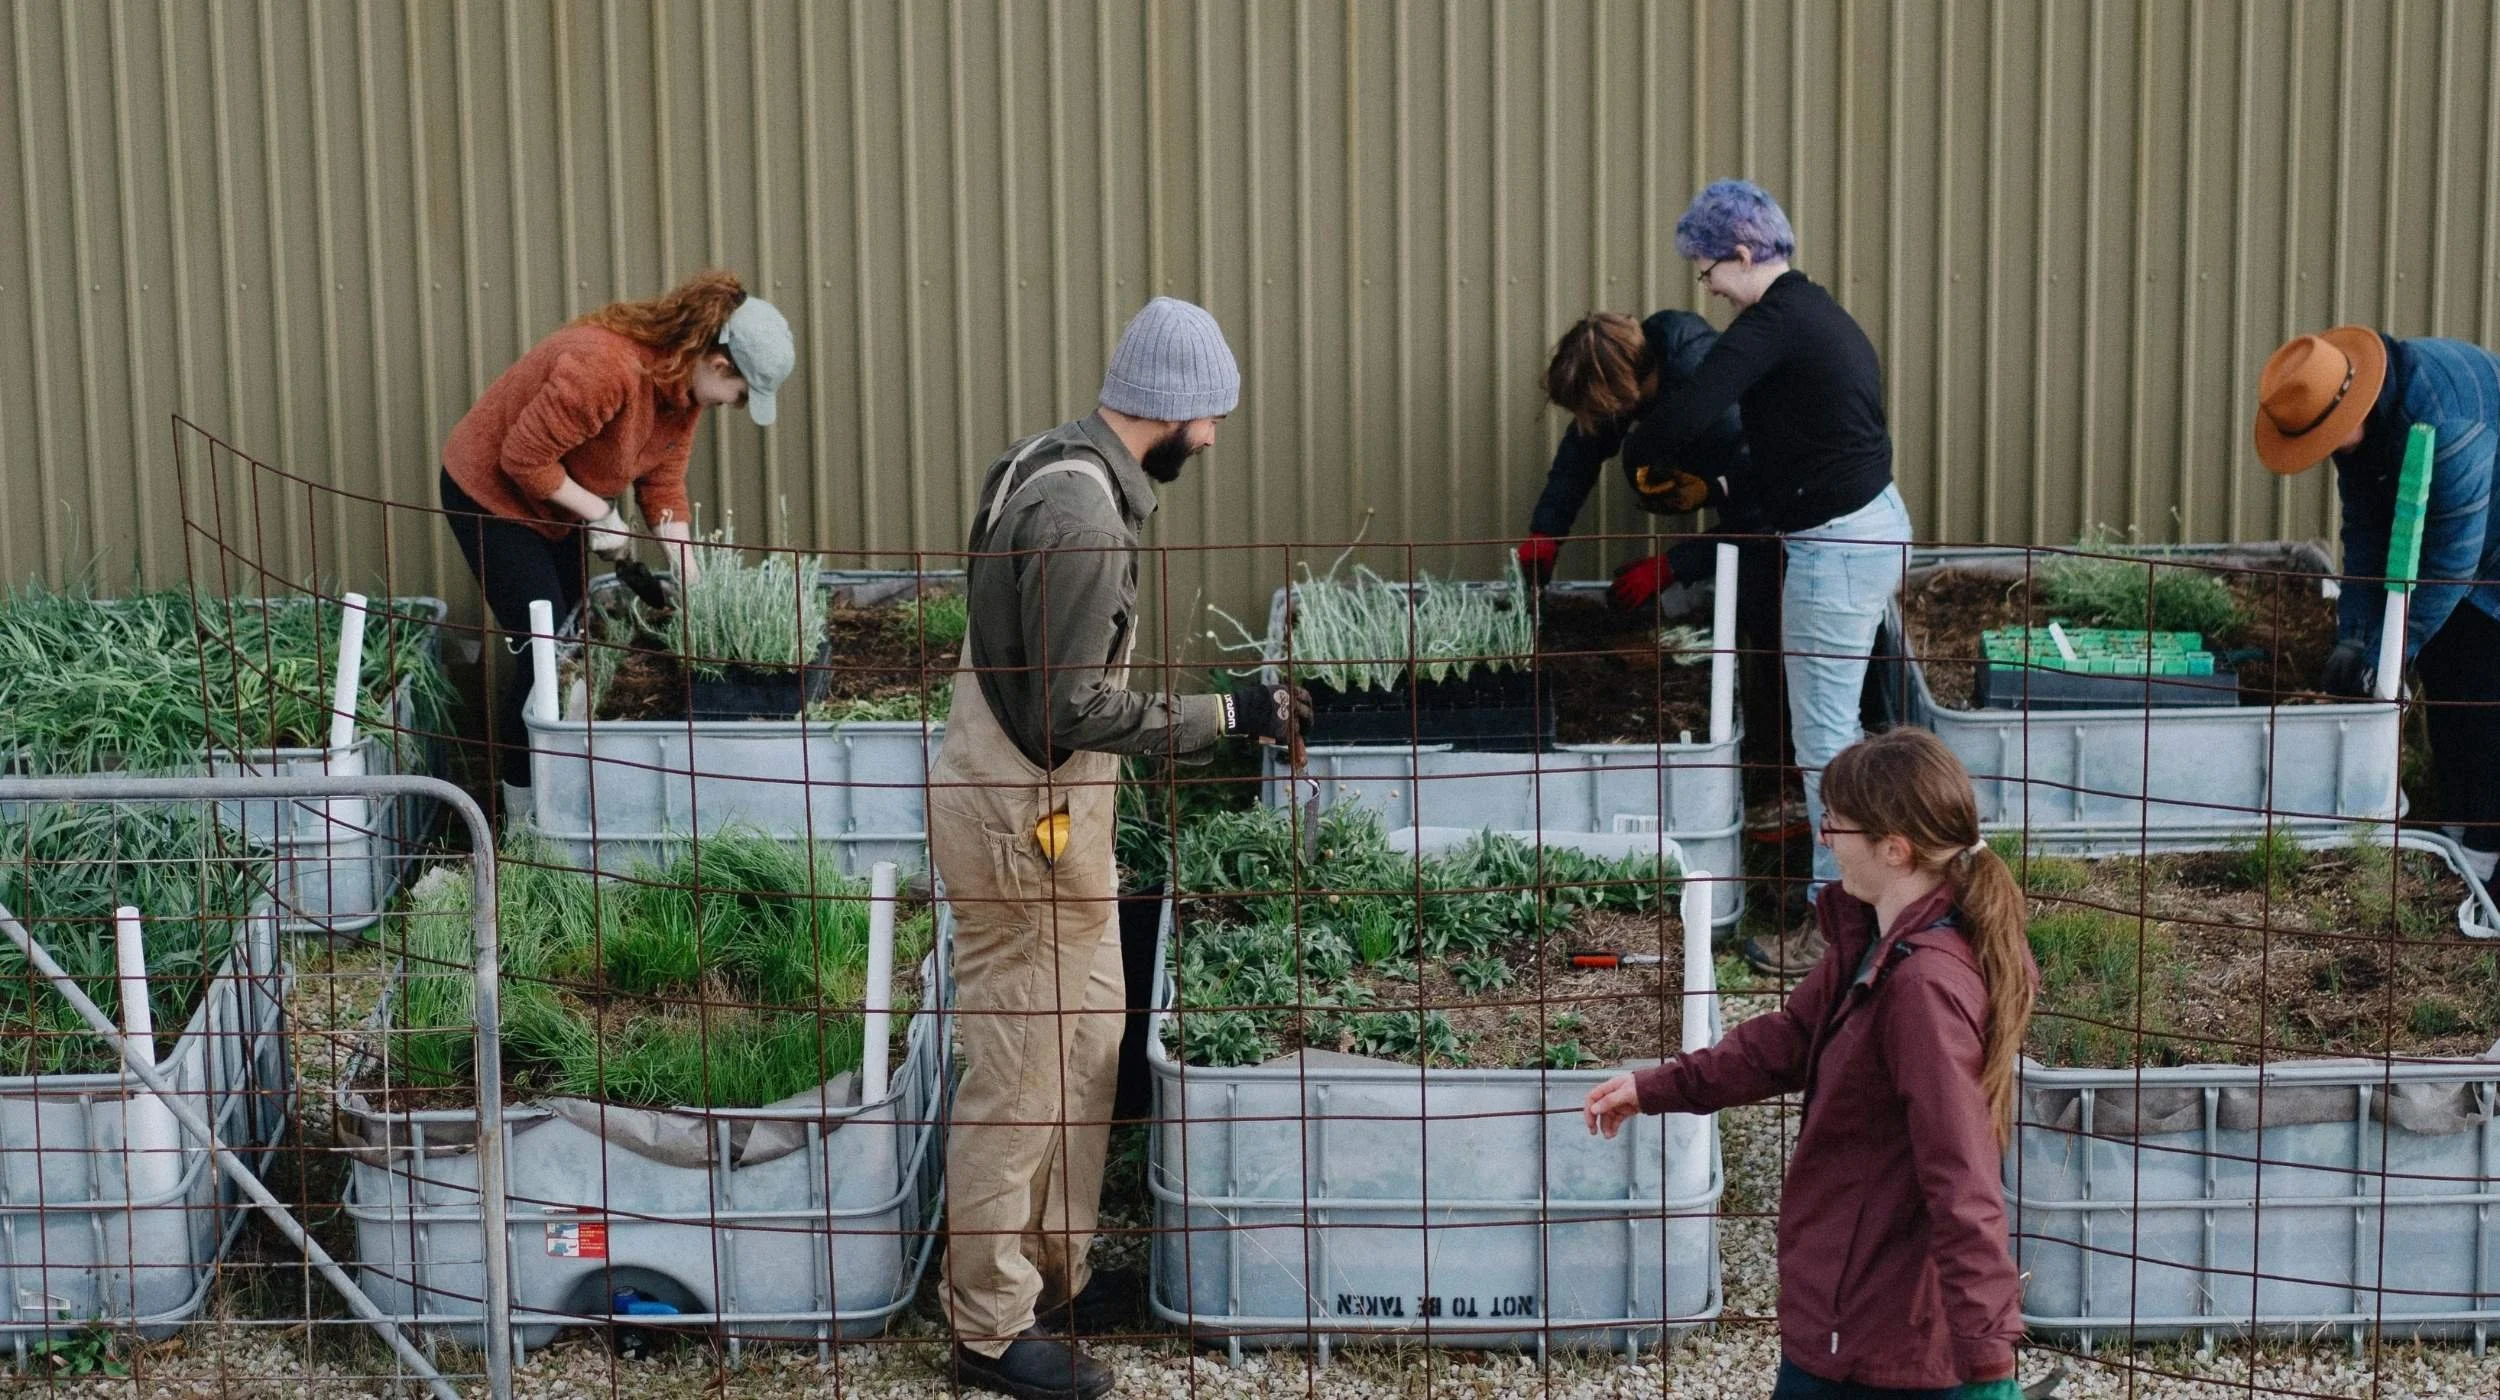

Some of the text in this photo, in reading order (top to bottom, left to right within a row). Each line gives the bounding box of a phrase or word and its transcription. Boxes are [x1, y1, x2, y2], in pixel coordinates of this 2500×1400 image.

[1336, 1293, 1533, 1317] NOT TO BE TAKEN
